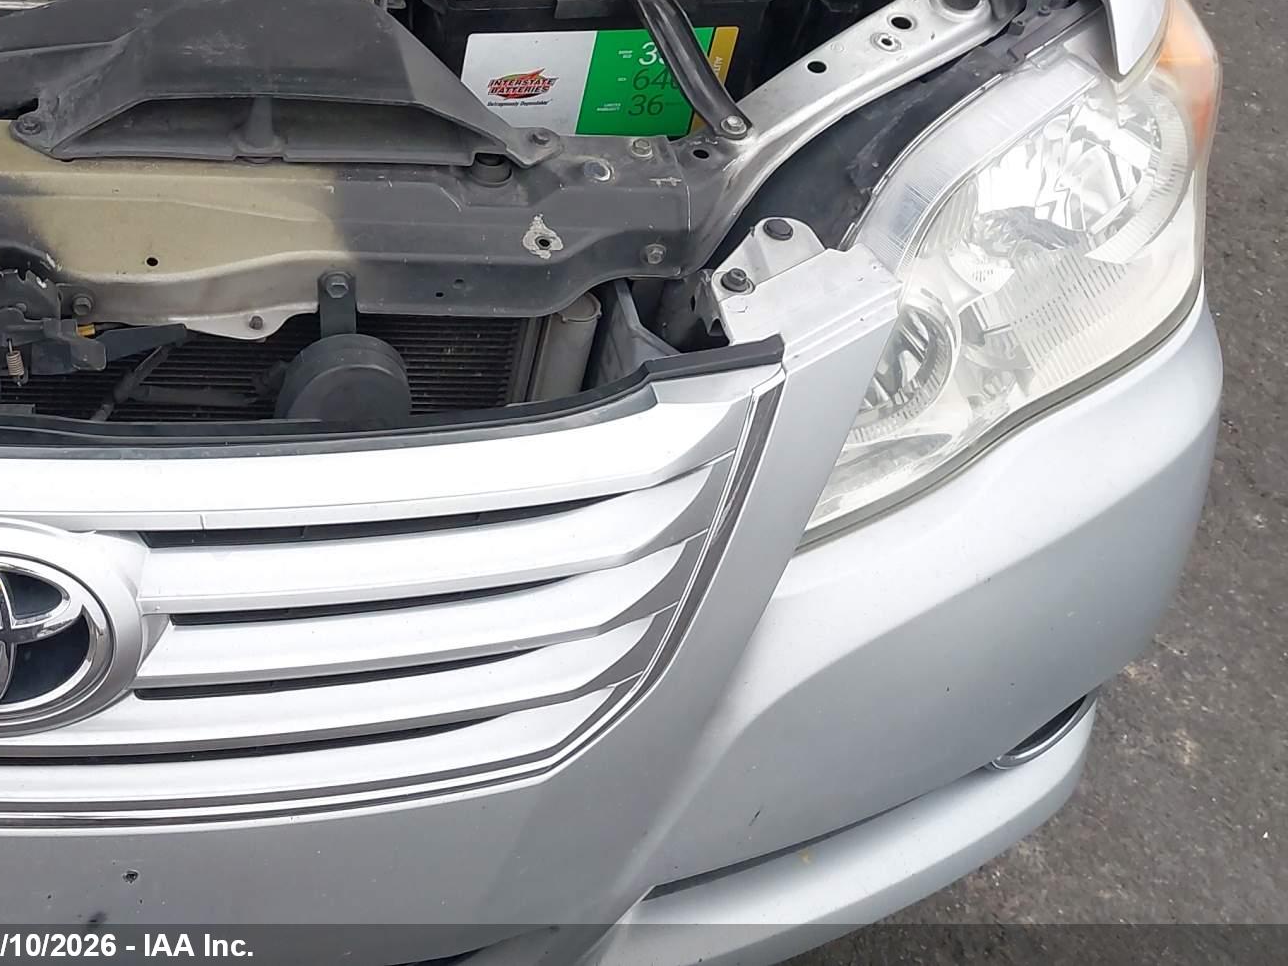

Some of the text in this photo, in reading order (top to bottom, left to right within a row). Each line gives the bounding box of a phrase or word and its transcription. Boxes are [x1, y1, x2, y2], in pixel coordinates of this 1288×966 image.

[638, 41, 665, 66] 3
[488, 78, 558, 87] INTERSTATE
[488, 86, 550, 95] BATTERIES
[627, 94, 663, 116] 36
